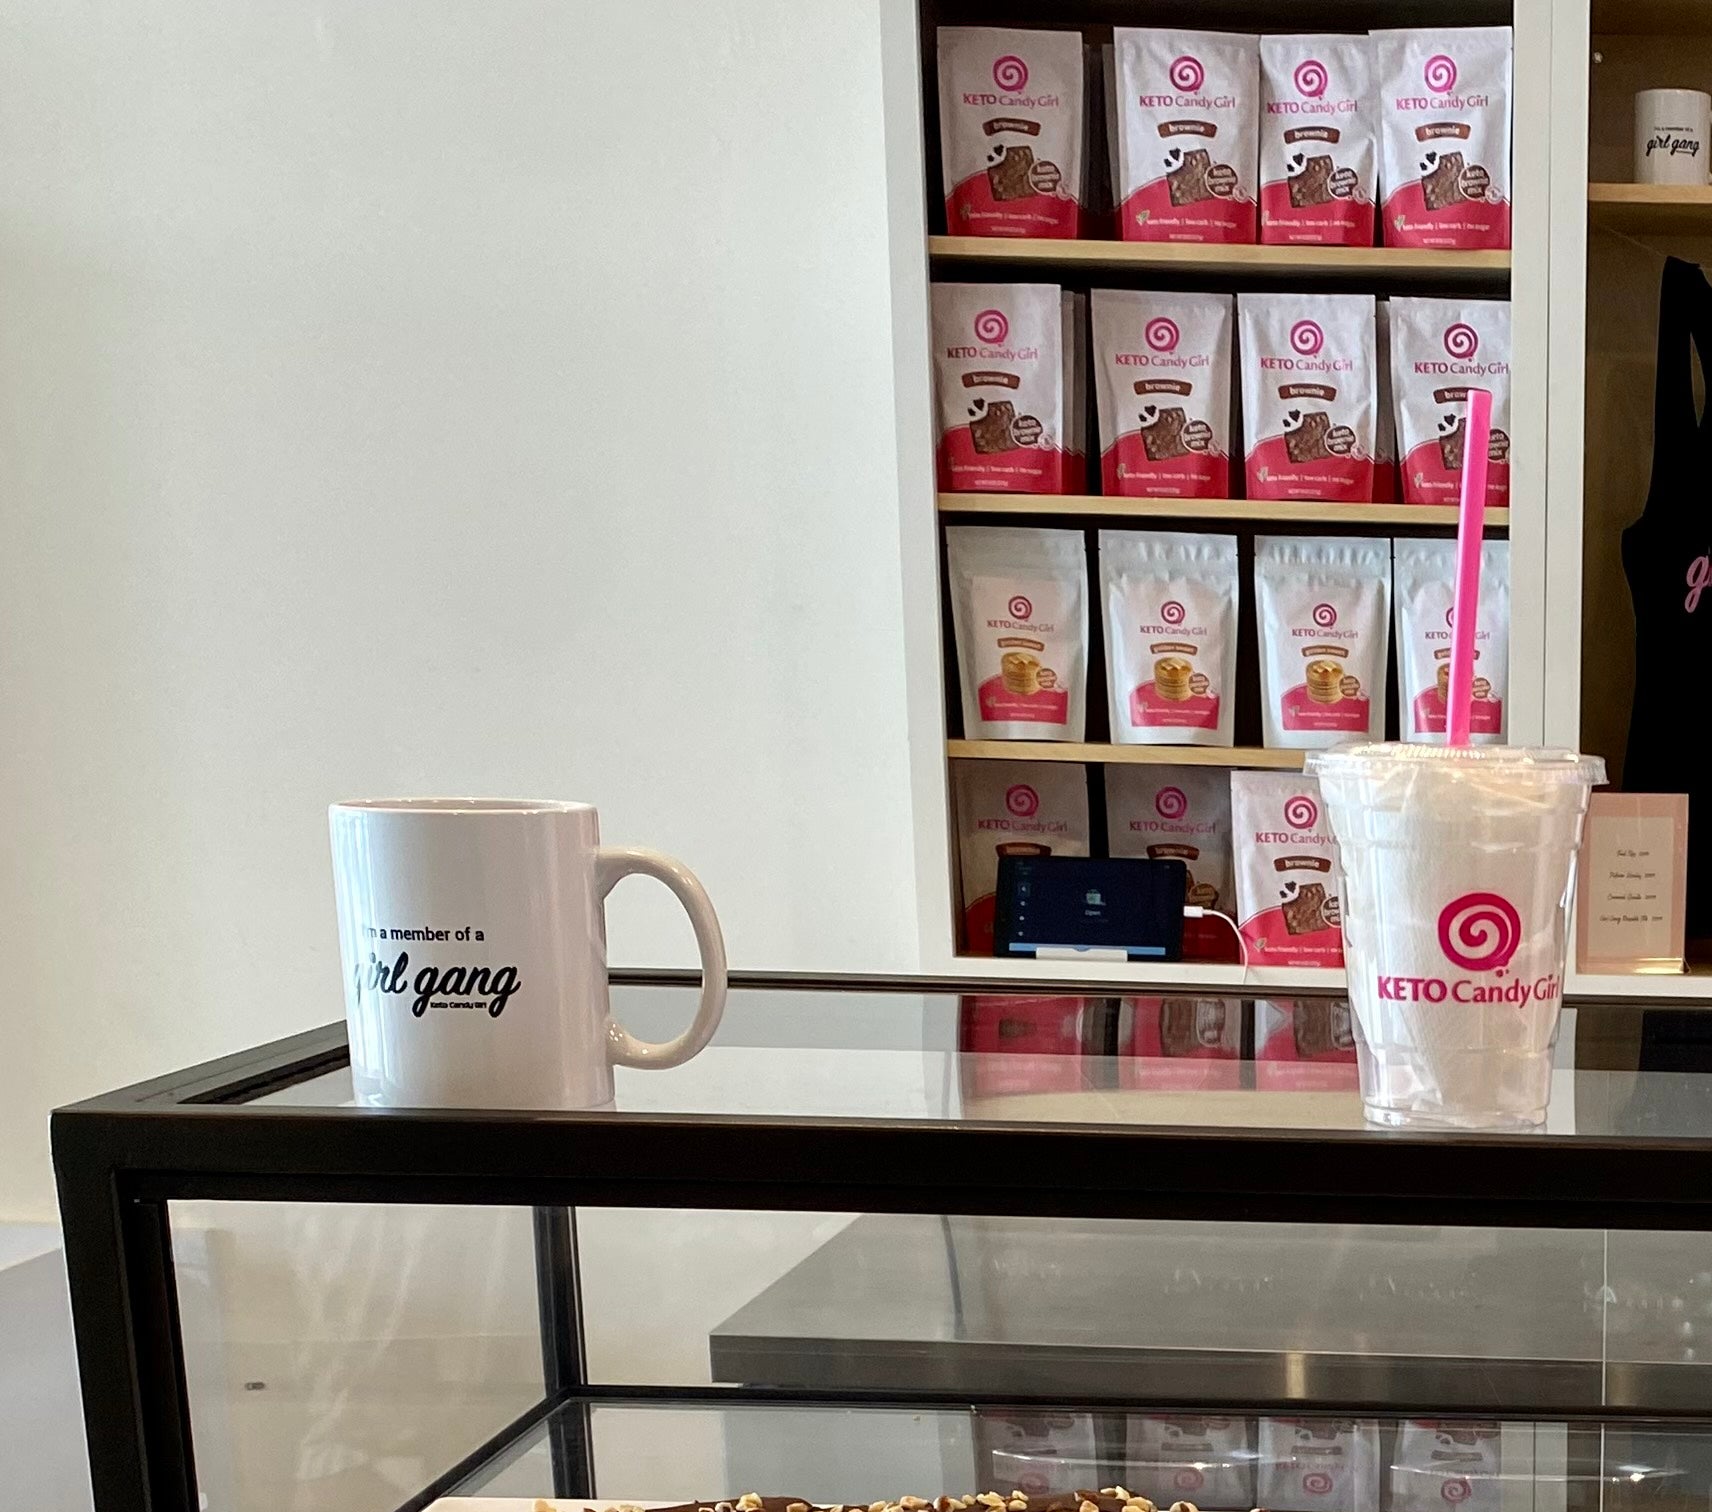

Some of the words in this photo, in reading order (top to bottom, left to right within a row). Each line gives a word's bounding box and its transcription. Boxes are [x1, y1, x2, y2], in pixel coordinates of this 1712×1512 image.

[963, 93, 996, 105] KETO
[999, 95, 1037, 110] Candy
[1037, 94, 1058, 107] Girl
[1139, 95, 1173, 107] KETO
[1175, 96, 1212, 109] Candy
[1213, 95, 1235, 108] Girl
[1267, 102, 1299, 114] KETO
[1302, 103, 1336, 116] Candy
[1337, 100, 1358, 112] Girl
[1396, 98, 1428, 110] KETO
[1430, 98, 1465, 110] Candy
[1467, 95, 1488, 108] Girl
[1168, 122, 1205, 132] brownie
[1294, 129, 1328, 139] brownie
[1425, 126, 1460, 136] brownie
[1646, 134, 1670, 156] girl
[1670, 138, 1700, 157] gang
[947, 347, 977, 359] KETO
[979, 348, 1017, 361] Candy
[1017, 348, 1038, 360] Girl
[1115, 353, 1149, 366] KETO
[1151, 356, 1188, 369] Candy
[1189, 354, 1209, 367] Girl
[1260, 357, 1293, 370] KETO
[1296, 359, 1332, 372] Candy
[1333, 359, 1353, 371] Girl
[1415, 362, 1448, 374] KETO
[1450, 363, 1486, 376] Candy
[1487, 362, 1509, 374] Girl
[1145, 382, 1180, 392] brownie
[1289, 387, 1325, 396] brownie
[1292, 628, 1315, 637] KETO
[1425, 631, 1448, 640] KETO
[1256, 832, 1289, 844] KETO
[1290, 833, 1327, 845] Candy
[1285, 860, 1320, 868] brownie
[380, 929, 387, 939] a
[391, 926, 450, 941] member
[455, 926, 470, 941] of
[475, 930, 484, 941] a
[412, 966, 521, 1018] gang
[1377, 976, 1447, 1003] KETO
[1451, 978, 1532, 1008] Candy
[1533, 974, 1559, 1001] Girl
